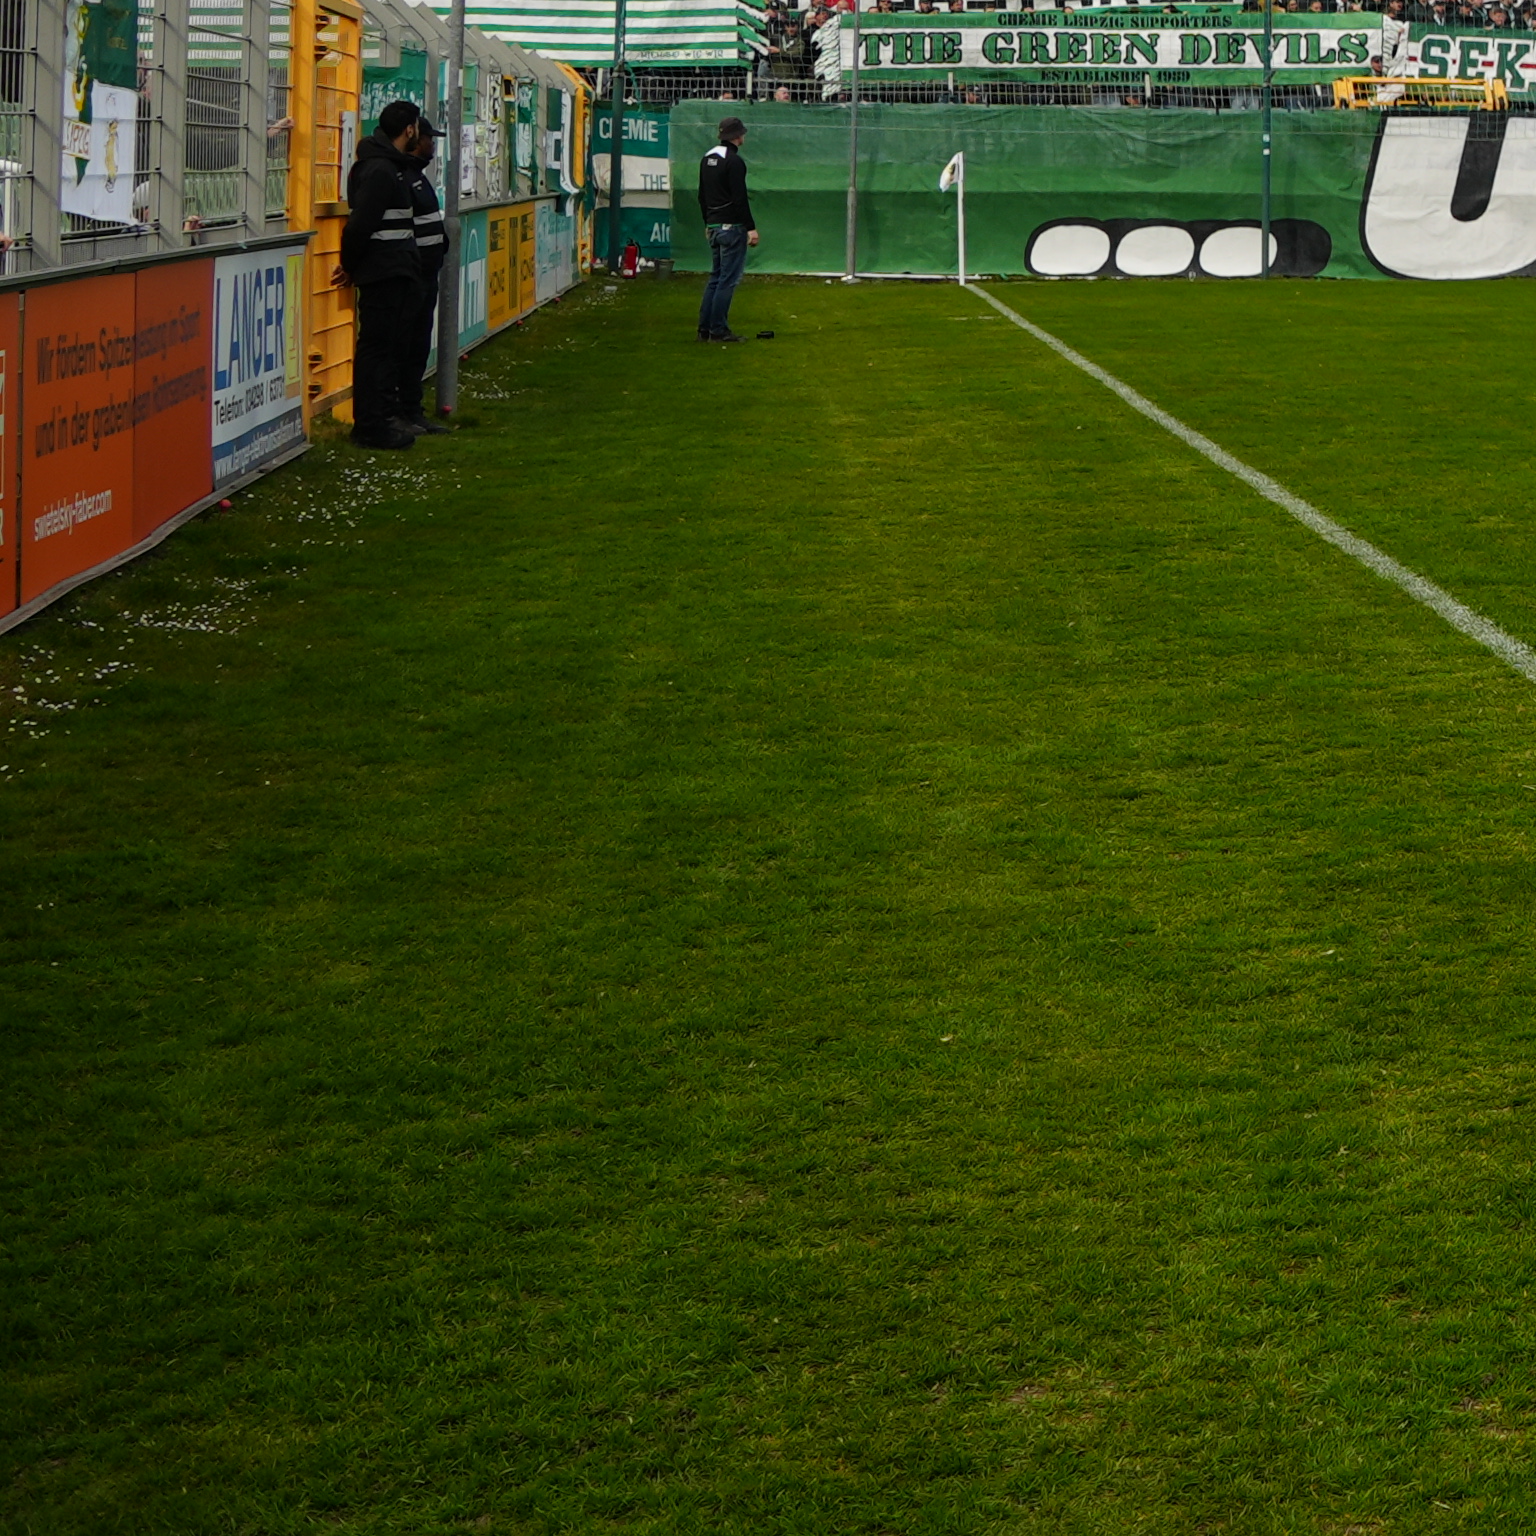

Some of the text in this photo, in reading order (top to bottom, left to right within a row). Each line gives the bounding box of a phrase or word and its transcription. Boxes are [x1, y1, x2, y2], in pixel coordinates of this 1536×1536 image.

[997, 11, 1233, 29] CHEMIE LEIPZIG SUPPORTERS
[859, 32, 1368, 66] THE GREEN DEVILS
[1041, 70, 1149, 83] ESTABLISHED
[640, 173, 669, 190] THE
[213, 265, 285, 392] LANGER
[37, 336, 54, 385] Wir
[56, 332, 96, 381] fördern
[35, 406, 55, 458] und
[70, 401, 90, 447] der
[35, 489, 112, 542] swietelsky-faber.com
